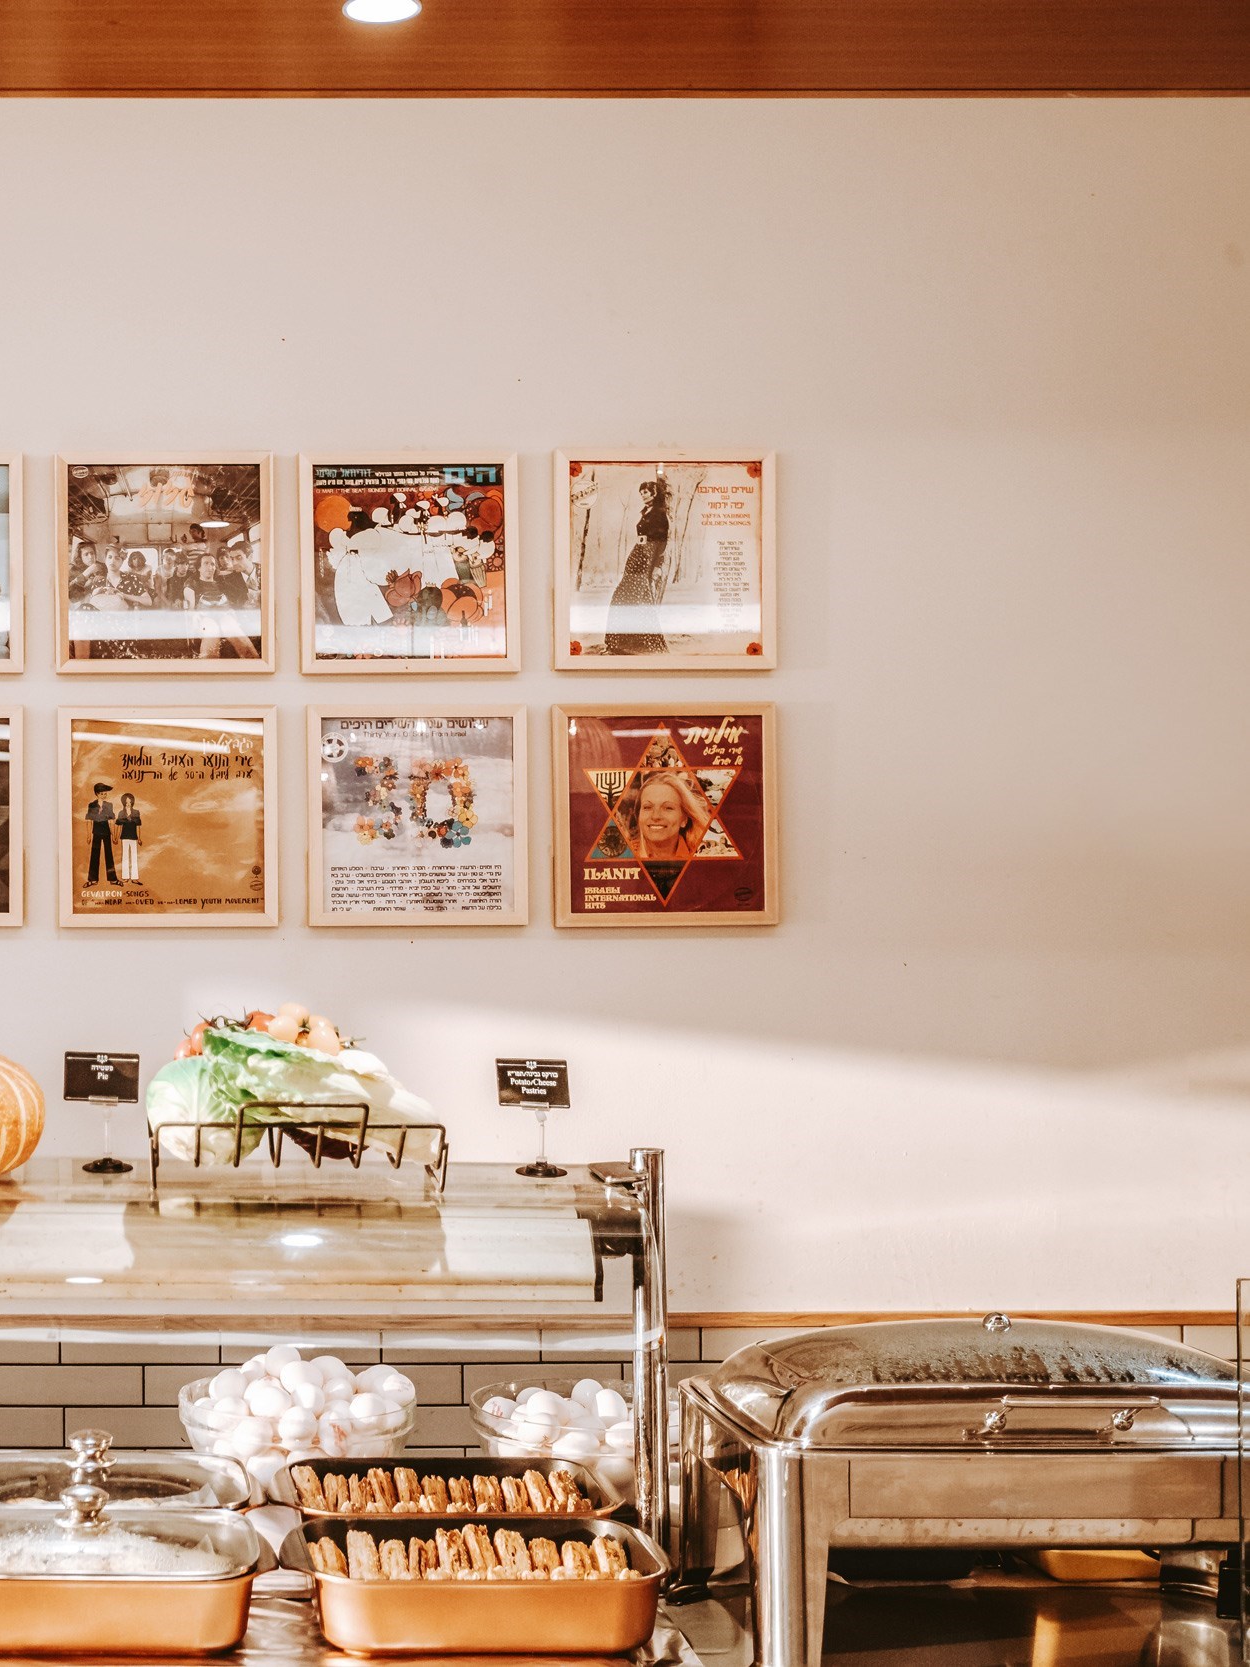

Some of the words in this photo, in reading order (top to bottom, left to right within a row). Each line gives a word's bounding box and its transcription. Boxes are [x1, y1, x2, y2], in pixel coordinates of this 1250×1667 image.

[442, 467, 496, 484] הים
[698, 486, 729, 494] שאהבנו
[731, 486, 754, 494] שירים
[708, 502, 728, 510] ירקוני
[730, 502, 744, 510] יפה
[340, 720, 372, 730] היפים
[447, 720, 489, 729] שושים
[684, 716, 744, 744] אילנית
[728, 746, 743, 754] שירי
[120, 746, 152, 770] והלומד
[202, 754, 230, 770] הנוער
[235, 754, 254, 766] שירי
[712, 755, 732, 766] ישראל
[734, 755, 744, 766] של
[169, 766, 178, 781] של
[584, 867, 641, 880] ILANIT
[81, 890, 123, 898] GEVATRON
[584, 894, 656, 902] INTERNATIONAL
[584, 902, 606, 910] HITS
[98, 1072, 108, 1080] Pie
[510, 1078, 556, 1086] Potato/Cheese
[522, 1086, 546, 1094] Pastries
